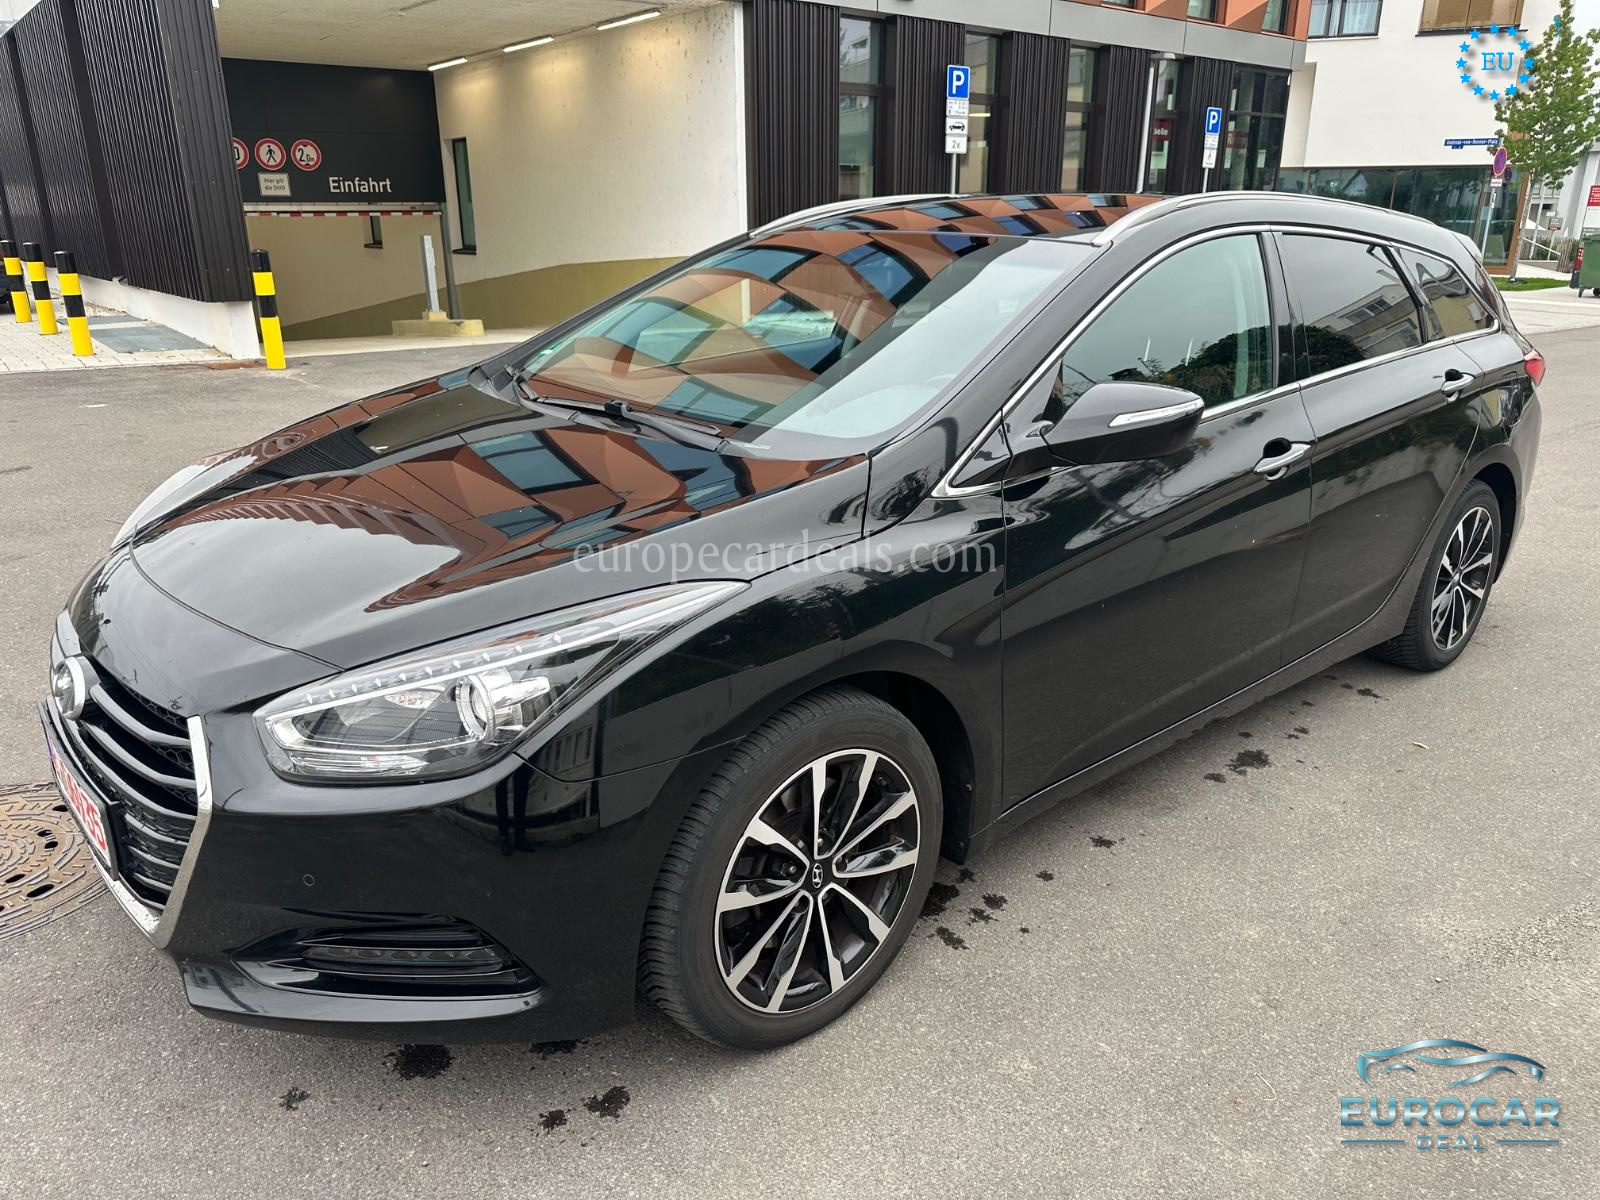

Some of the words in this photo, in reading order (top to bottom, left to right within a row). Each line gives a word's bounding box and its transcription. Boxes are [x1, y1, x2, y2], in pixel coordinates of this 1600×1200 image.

[952, 70, 965, 94] P
[1209, 111, 1218, 131] P
[328, 176, 392, 193] Einfahrt
